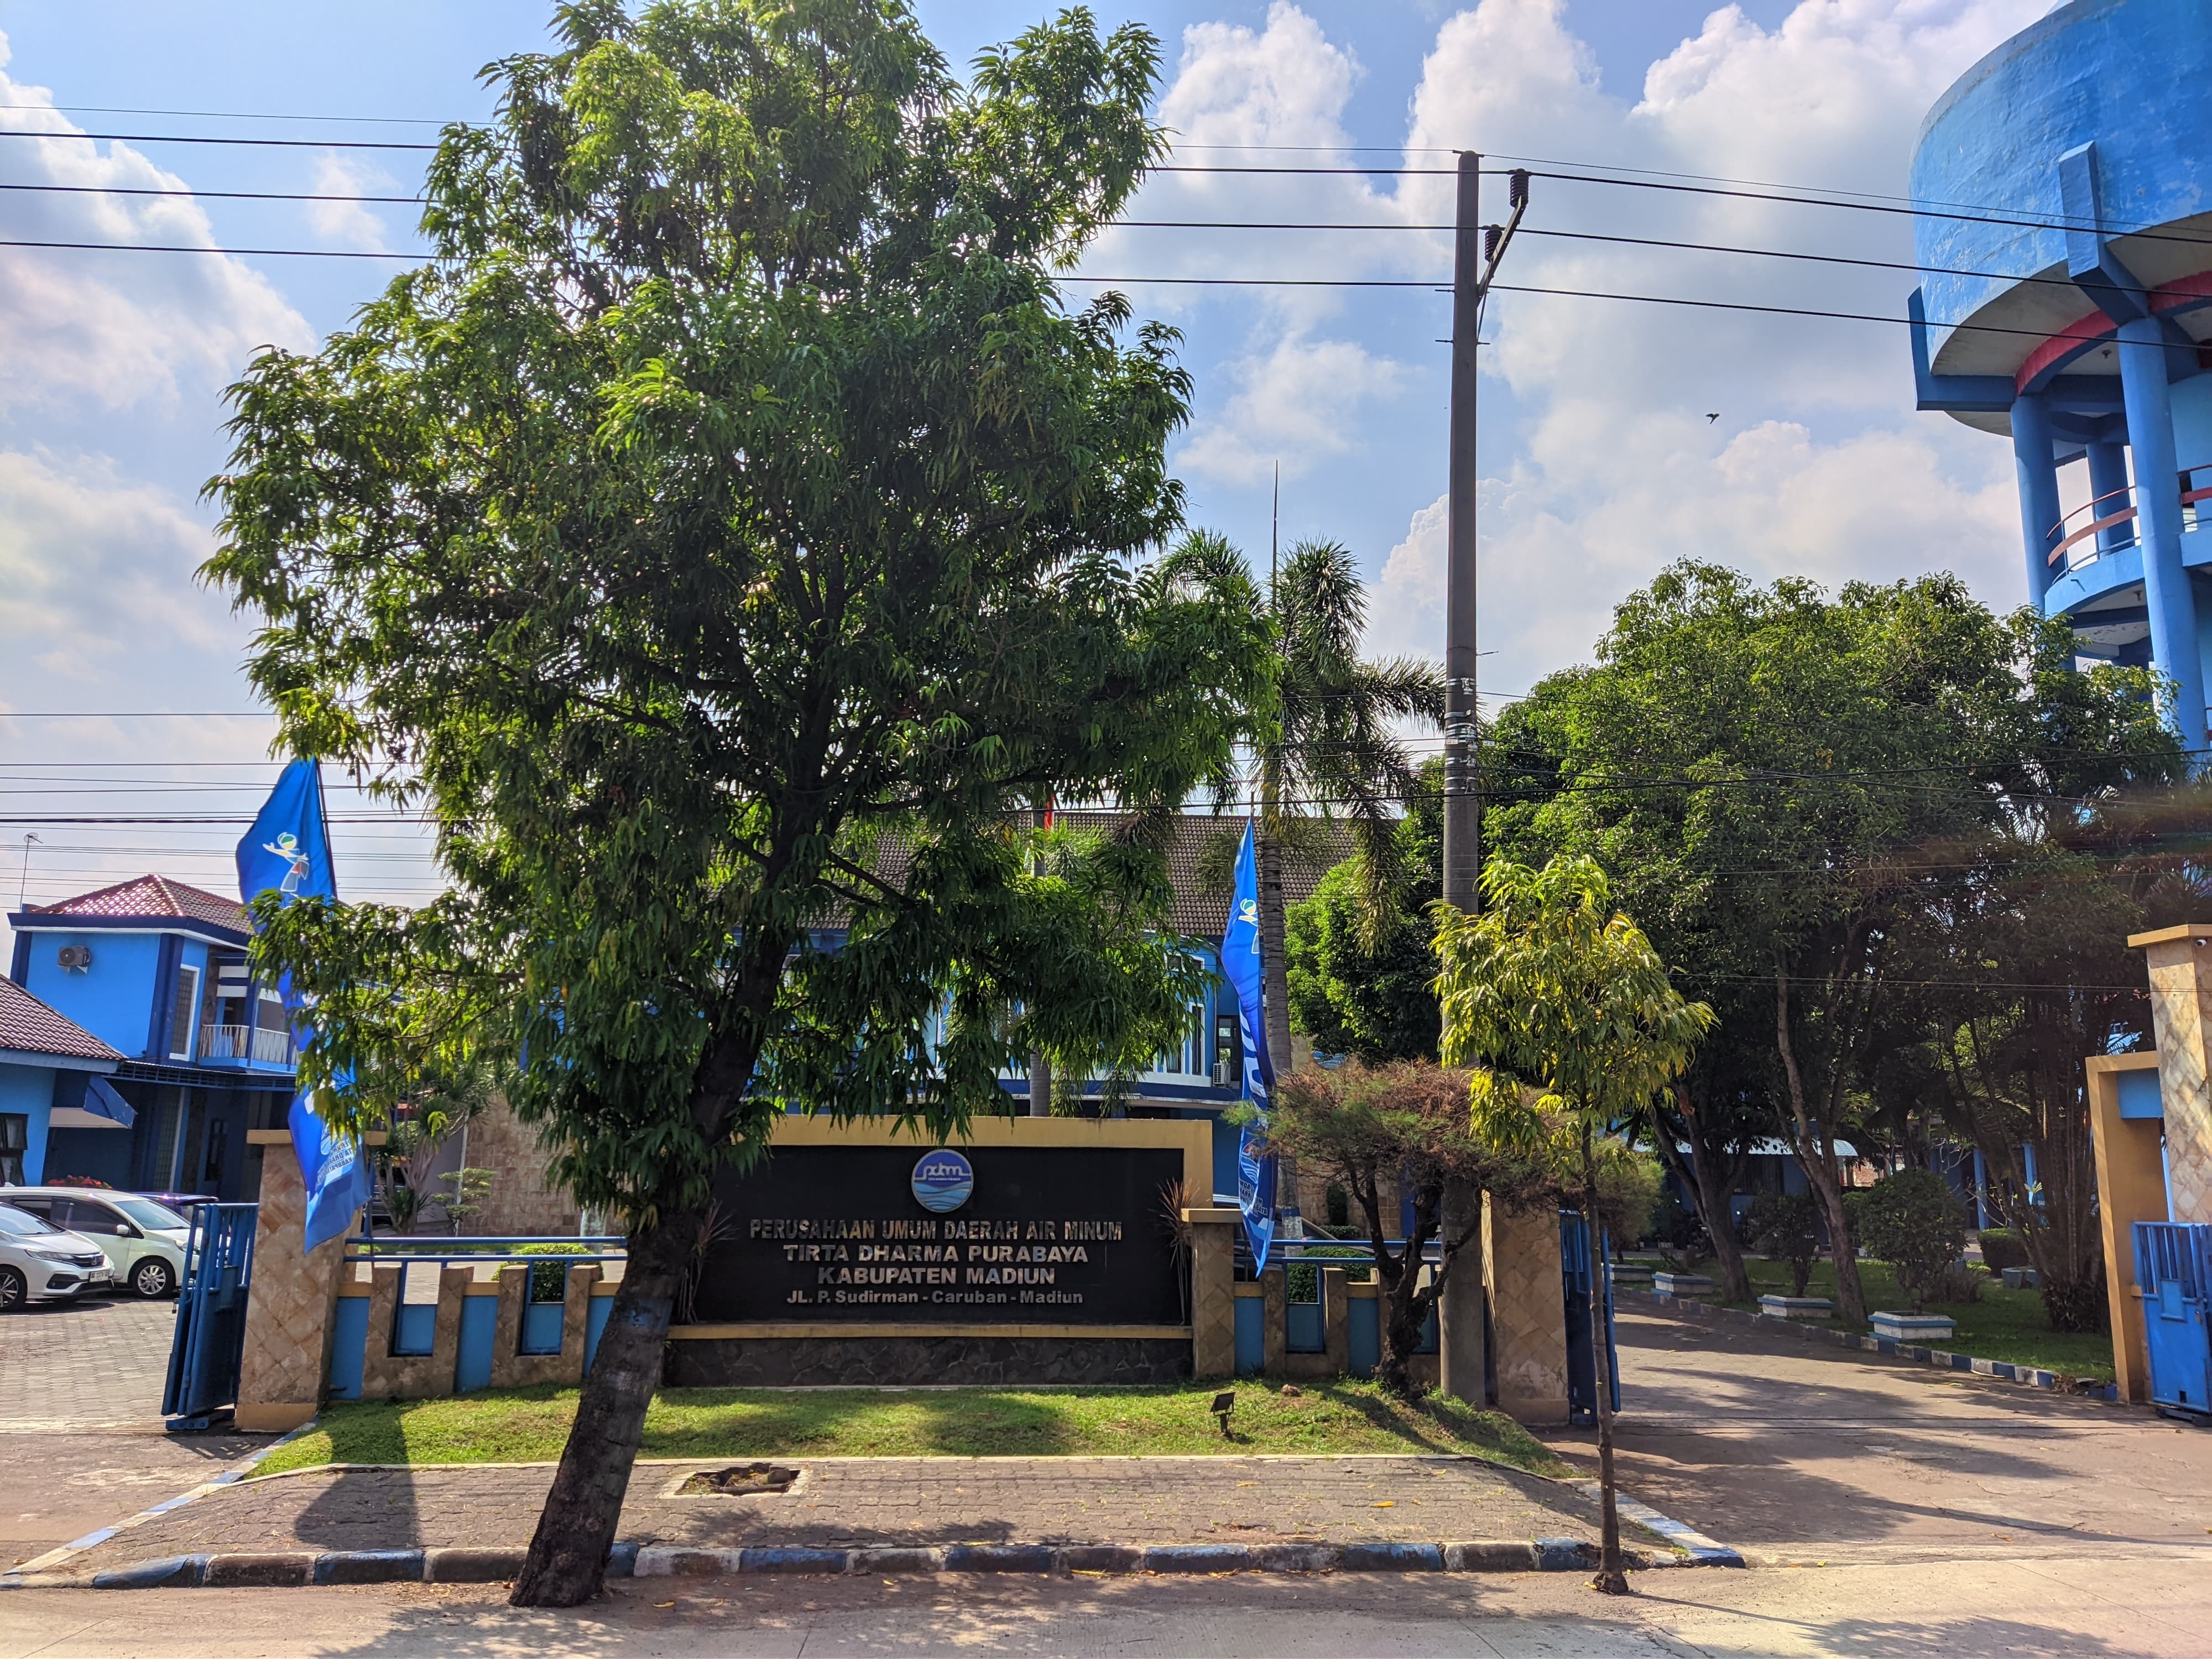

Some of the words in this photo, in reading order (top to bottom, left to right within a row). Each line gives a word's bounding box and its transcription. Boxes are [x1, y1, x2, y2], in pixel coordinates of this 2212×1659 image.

[750, 1219, 875, 1239] PERUSAHAAN
[882, 1220, 936, 1239] UMUM
[944, 1220, 1018, 1240] DAERAH
[1026, 1221, 1056, 1240] AIR
[1064, 1221, 1122, 1241] MINUM
[783, 1244, 849, 1261] TIRTA
[858, 1245, 959, 1262] DHARMA
[968, 1245, 1089, 1262] PURABAYA
[818, 1267, 956, 1284] KABUPATEN
[966, 1267, 1055, 1284] MADIUN
[787, 1290, 813, 1303] JL.
[817, 1290, 831, 1303] P.
[834, 1290, 918, 1304] Sudirman
[932, 1290, 1007, 1304] Caruban
[1020, 1290, 1083, 1304] Madiun
